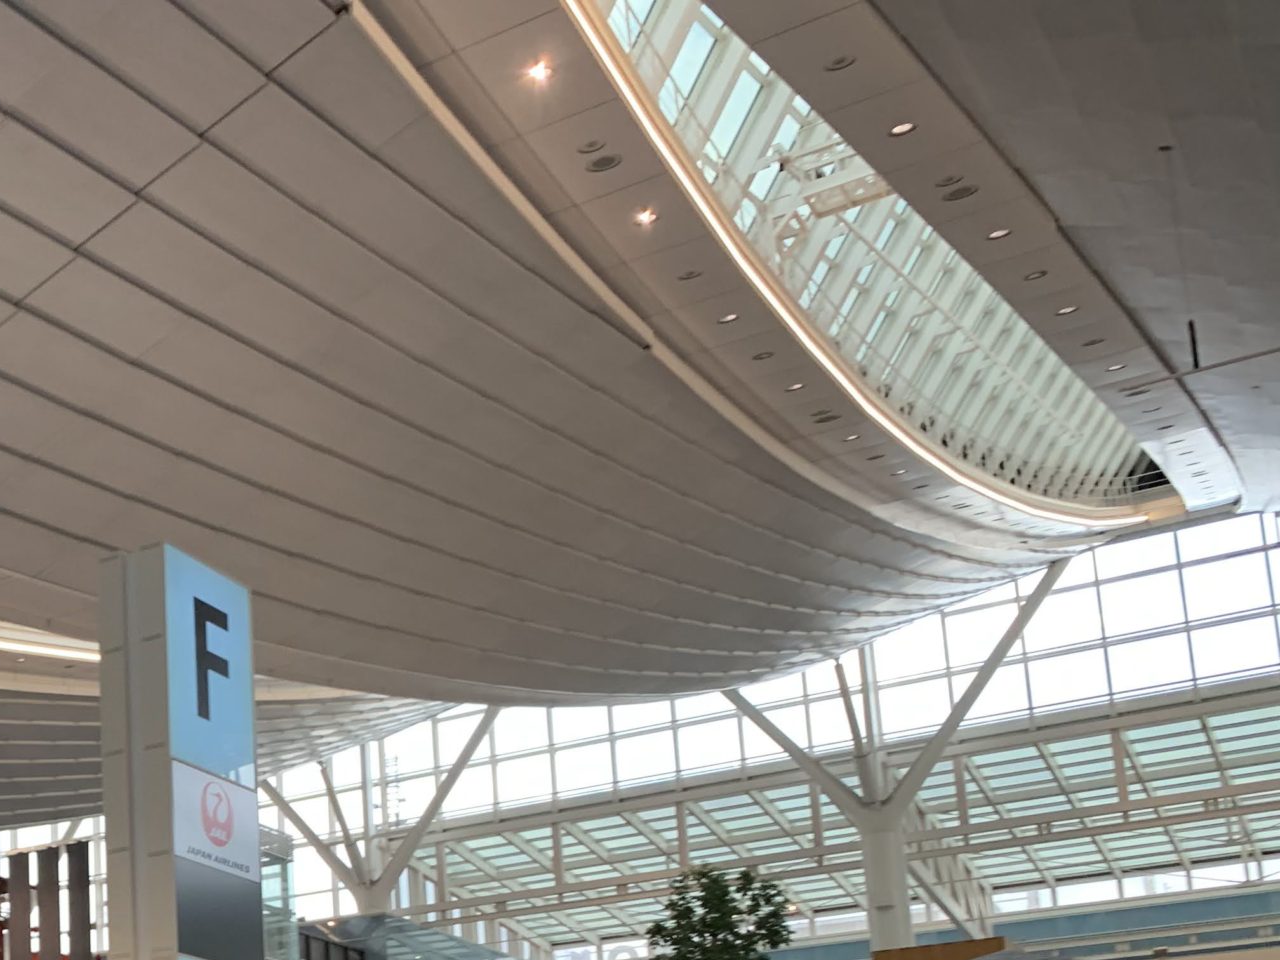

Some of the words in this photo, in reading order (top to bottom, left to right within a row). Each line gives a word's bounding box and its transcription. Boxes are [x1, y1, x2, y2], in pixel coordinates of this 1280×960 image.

[194, 596, 229, 721] F
[187, 846, 212, 861] JAPAN
[213, 855, 250, 873] AIRLINES
